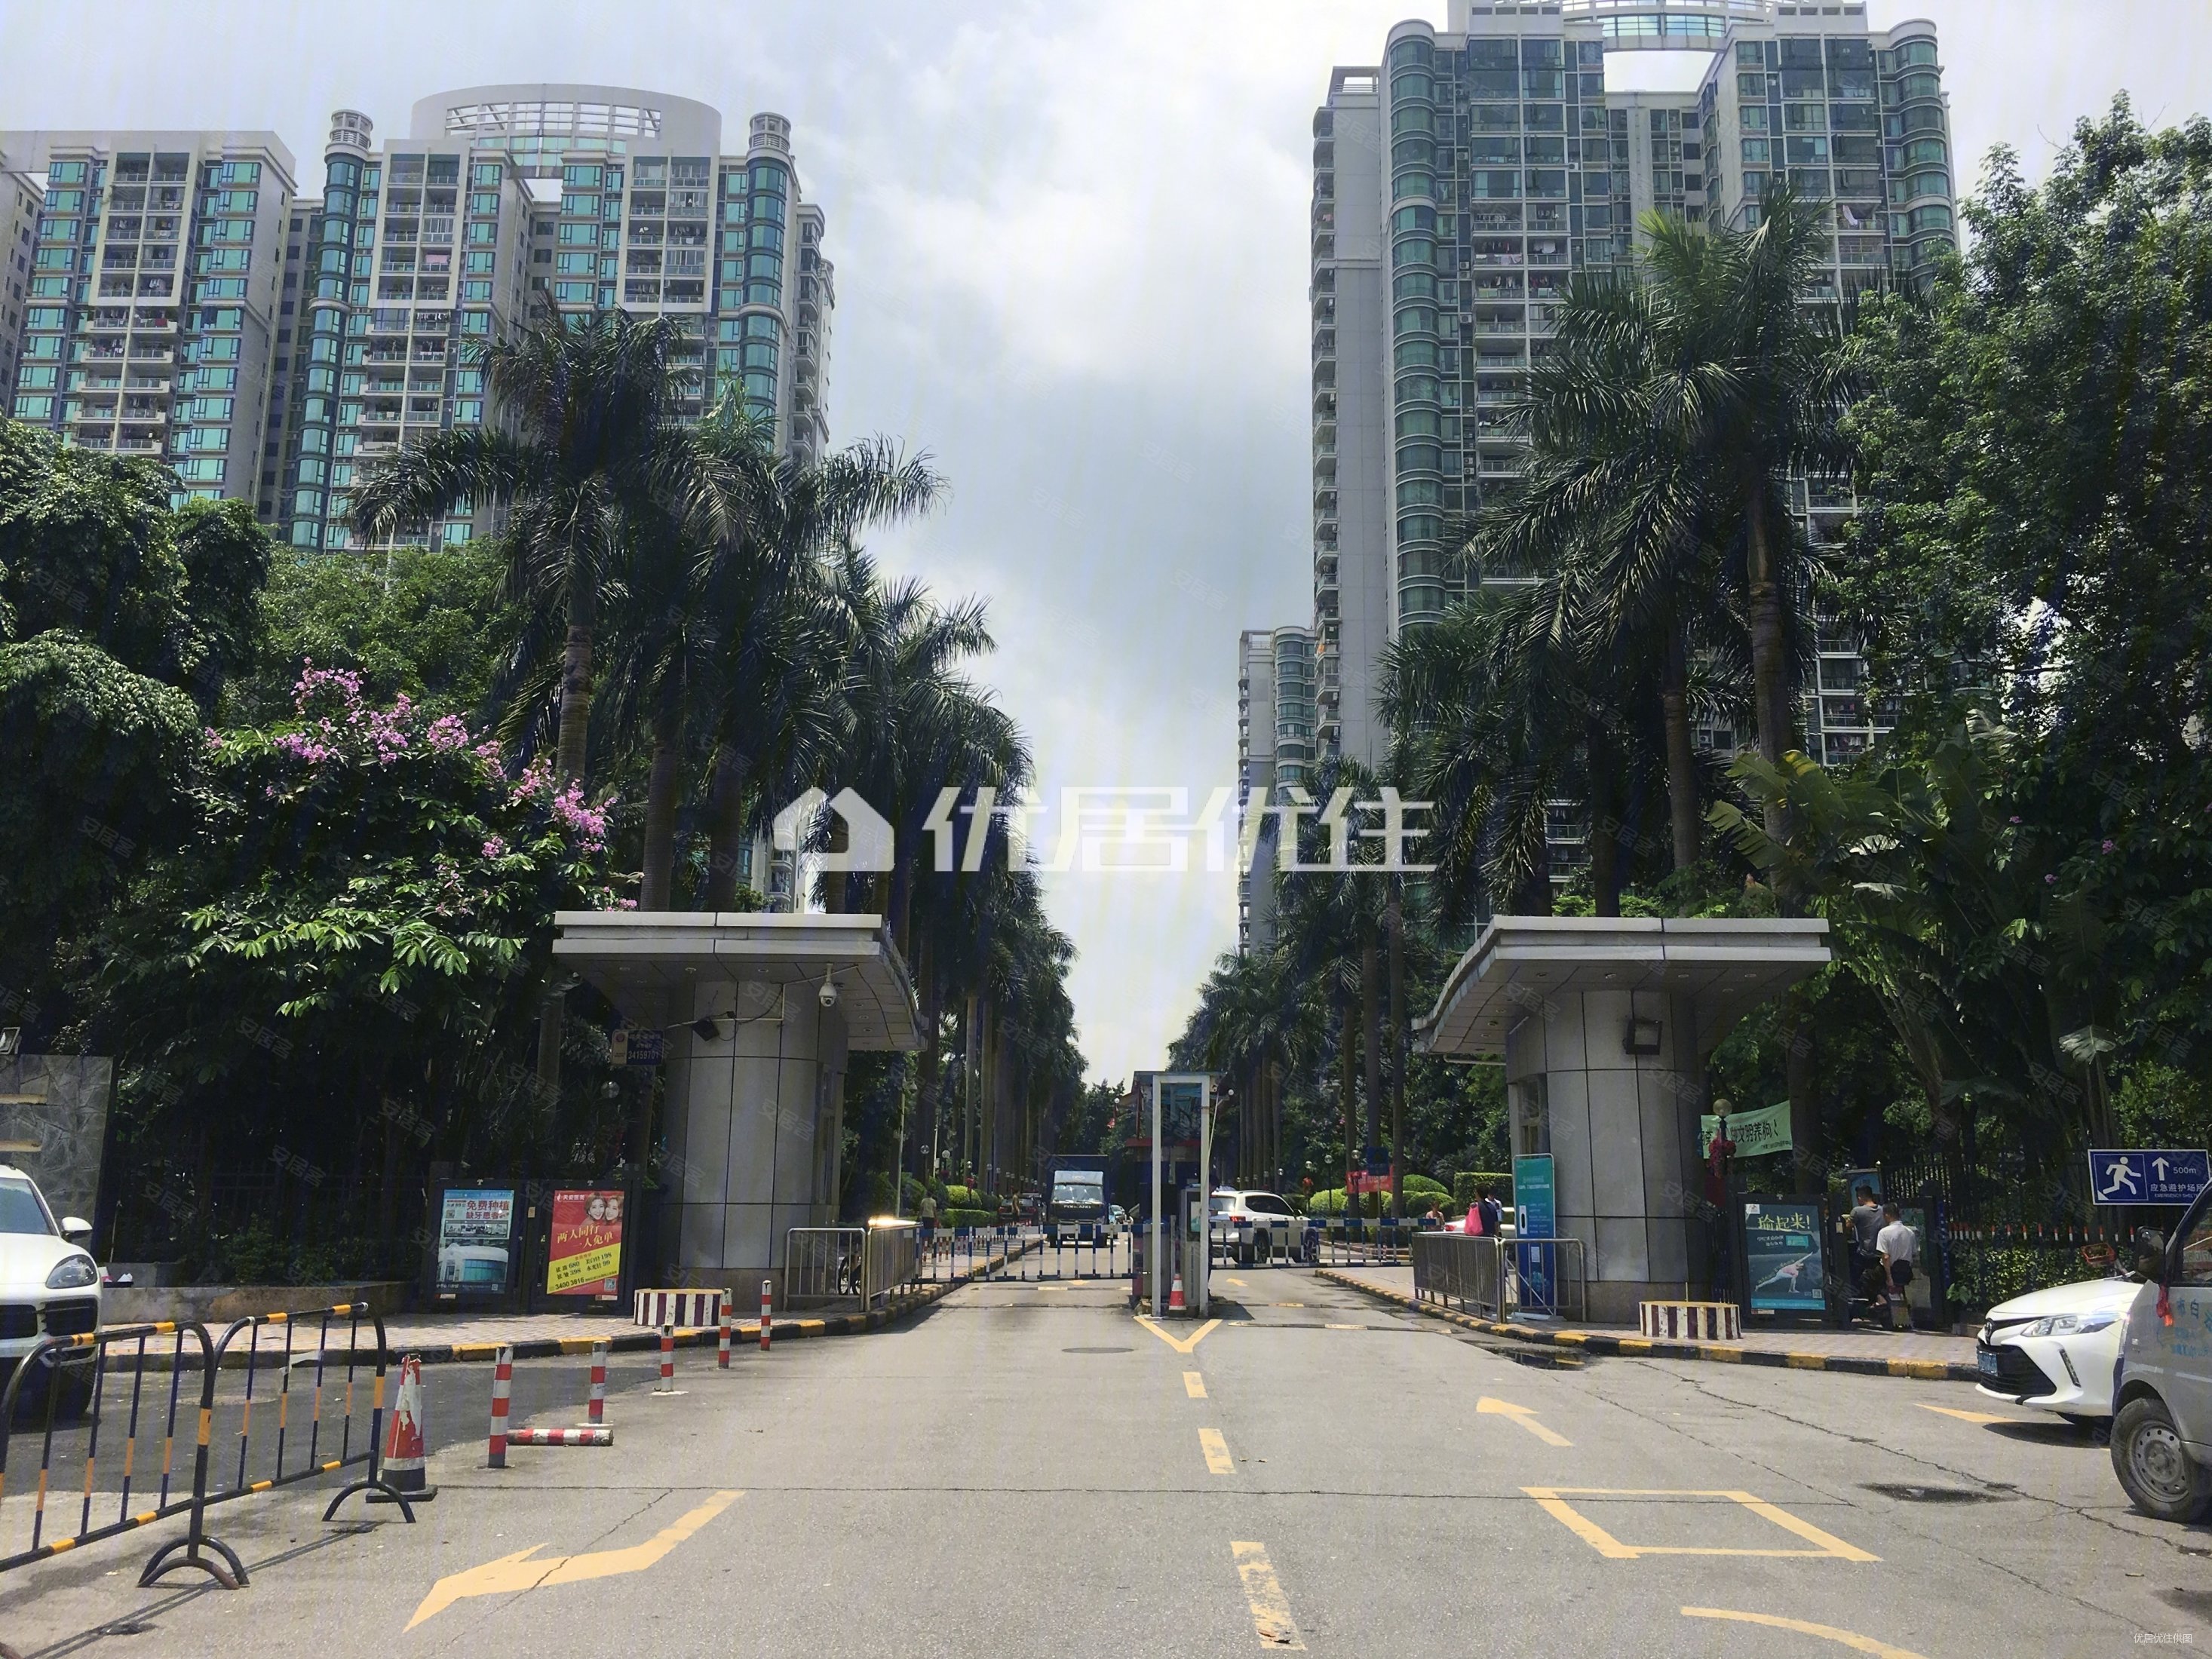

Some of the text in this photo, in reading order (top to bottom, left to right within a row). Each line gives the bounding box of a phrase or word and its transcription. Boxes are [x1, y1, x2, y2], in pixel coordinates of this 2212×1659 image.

[466, 1200, 510, 1211] 免费种植
[557, 1224, 600, 1243] 两人同行
